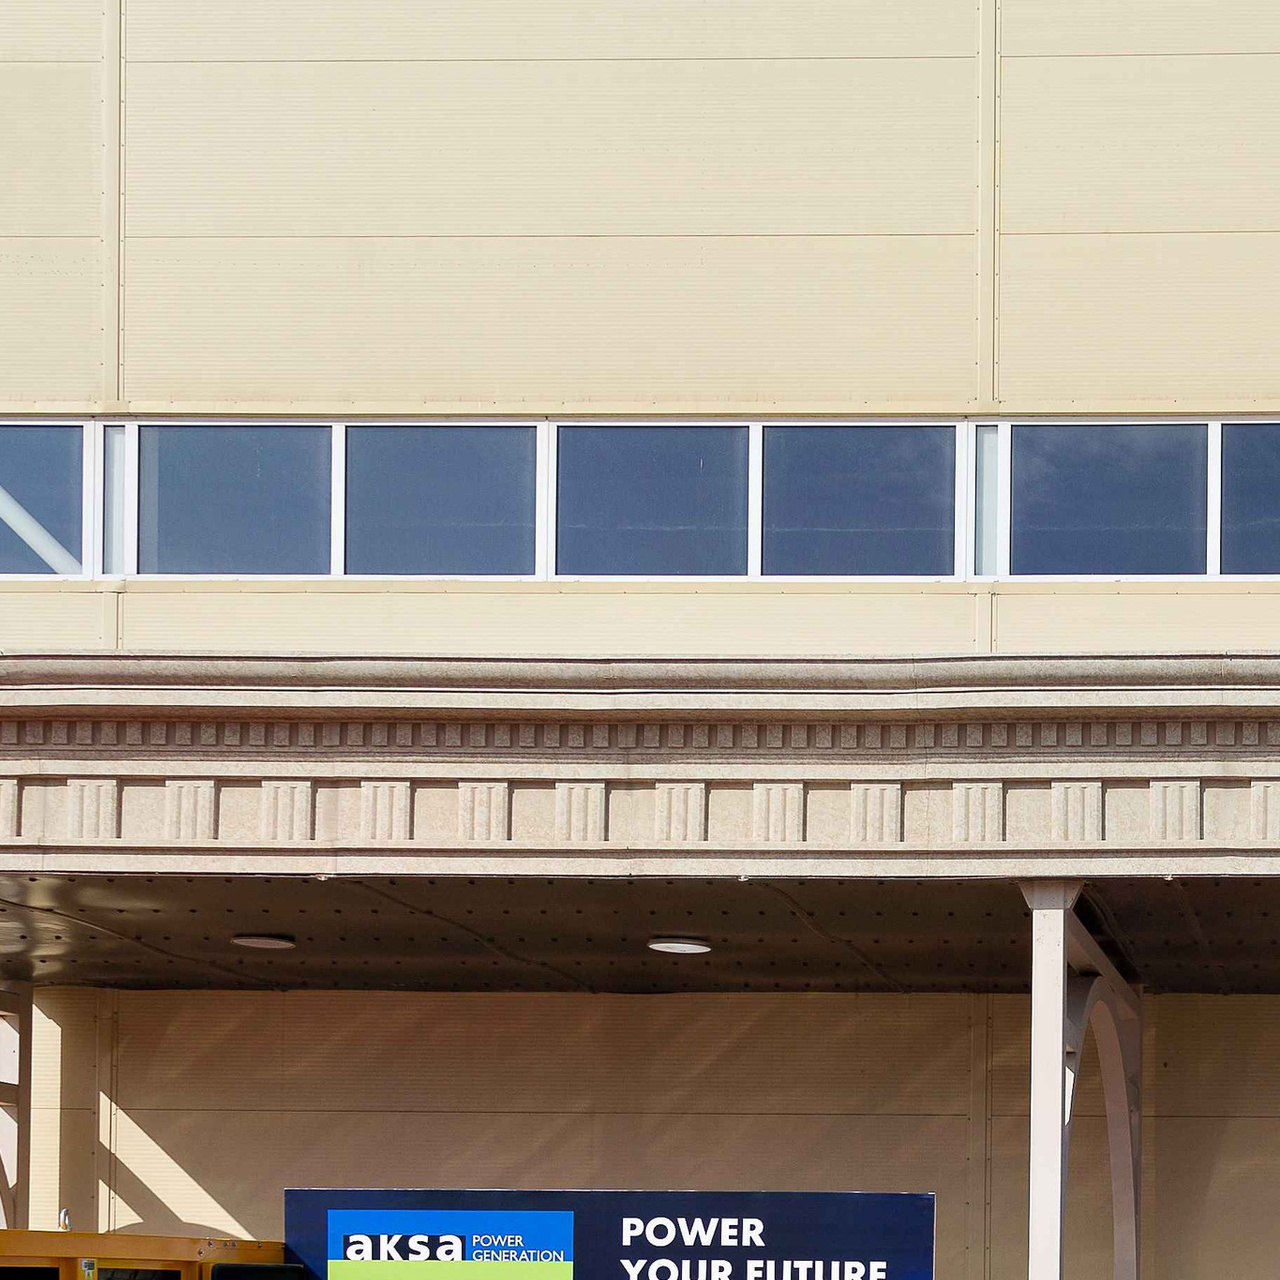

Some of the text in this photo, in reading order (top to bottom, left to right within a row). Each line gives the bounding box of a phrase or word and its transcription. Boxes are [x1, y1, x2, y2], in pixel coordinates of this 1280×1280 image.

[472, 1235, 525, 1247] POWER
[621, 1216, 766, 1247] POWER
[345, 1234, 463, 1261] aksa
[471, 1250, 564, 1262] GENERATION
